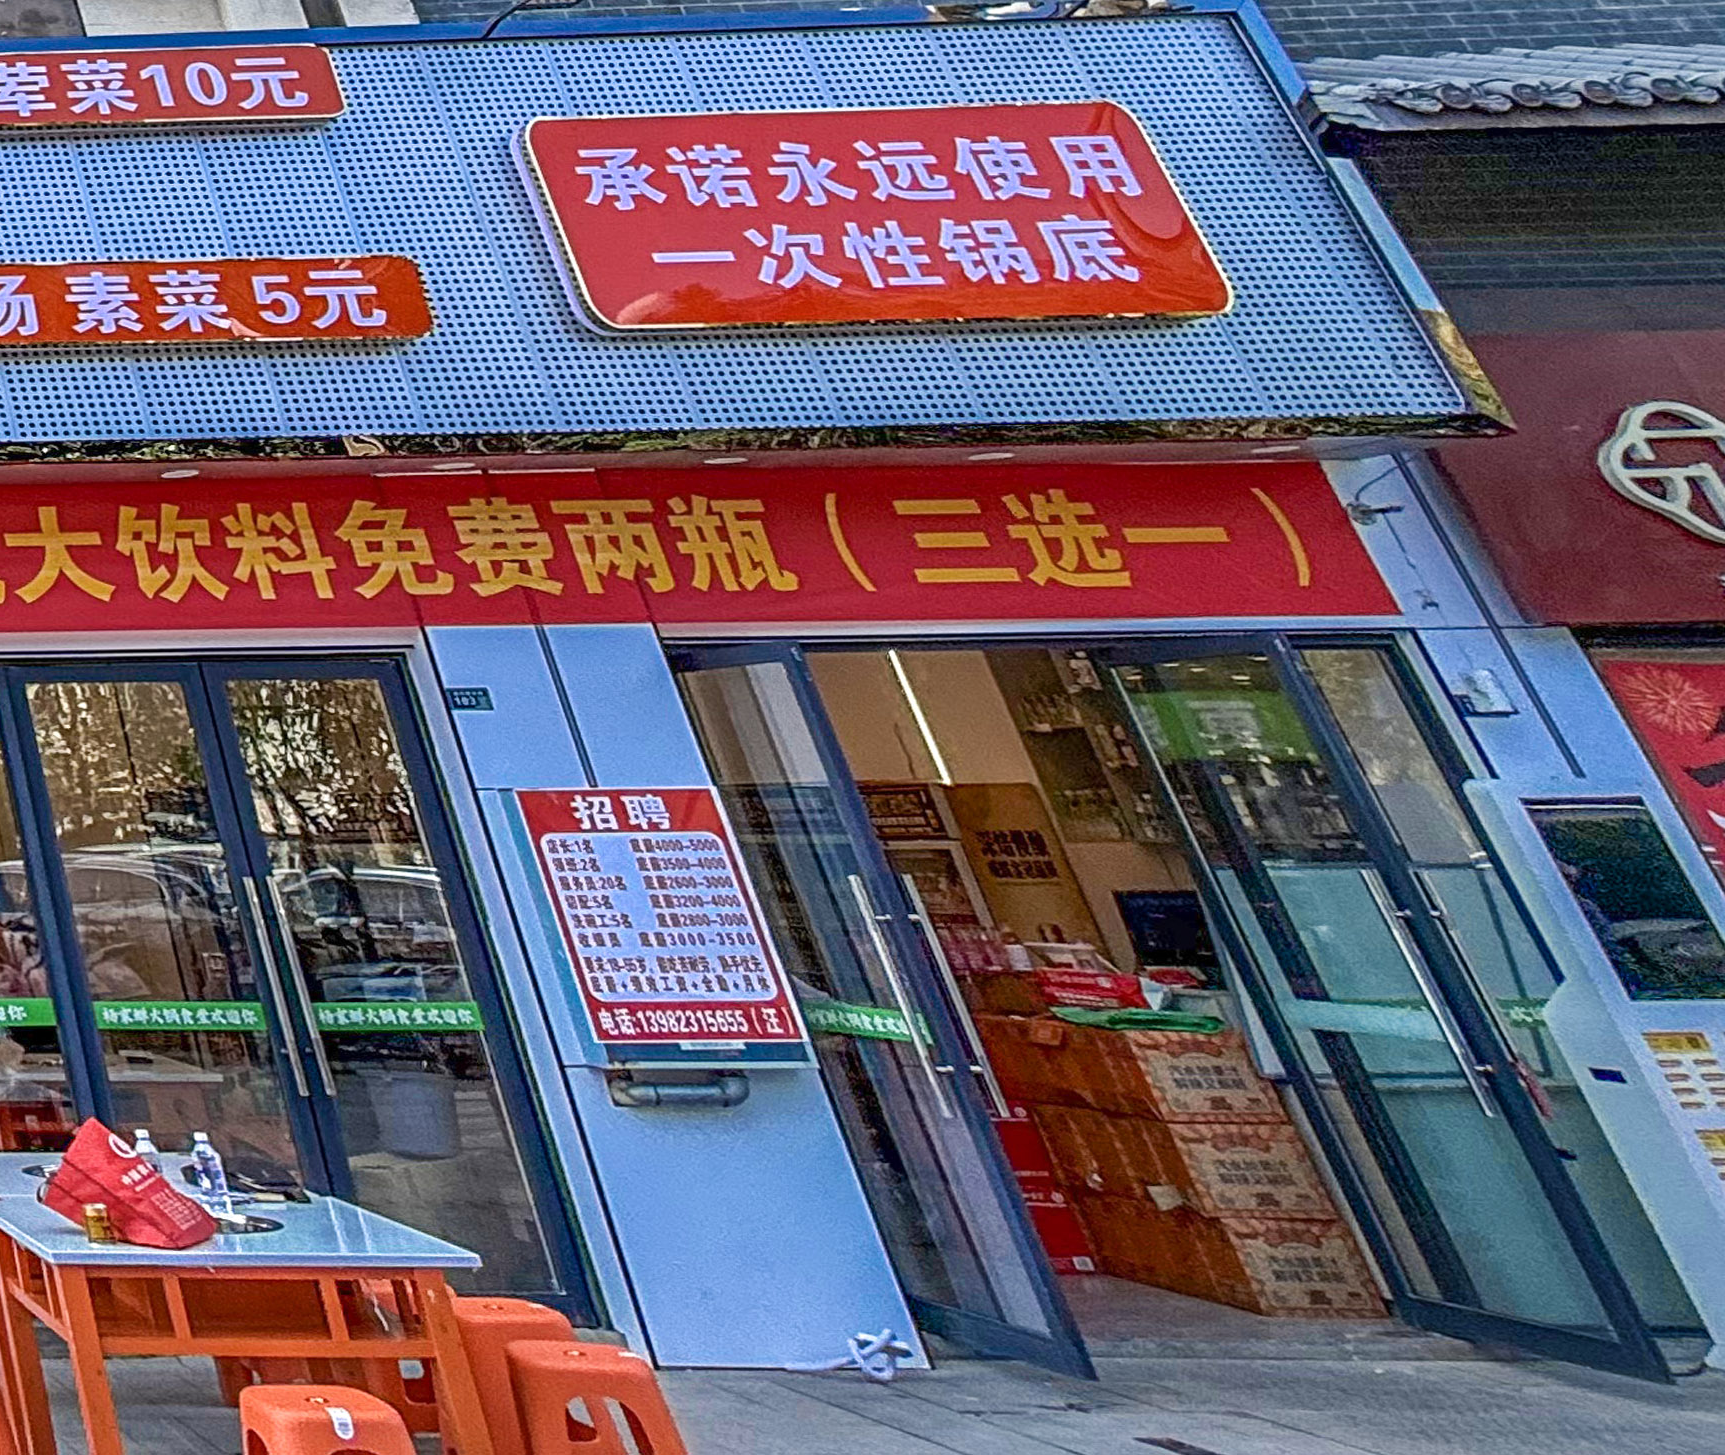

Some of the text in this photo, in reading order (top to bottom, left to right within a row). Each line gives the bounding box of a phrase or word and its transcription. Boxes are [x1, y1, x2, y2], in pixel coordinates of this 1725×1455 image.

[574, 133, 1145, 212] 承诺永远使用
[652, 214, 1141, 289] 一次性锅底
[64, 269, 233, 335] 素菜
[253, 268, 388, 328] 5元
[570, 794, 670, 831] 招聘
